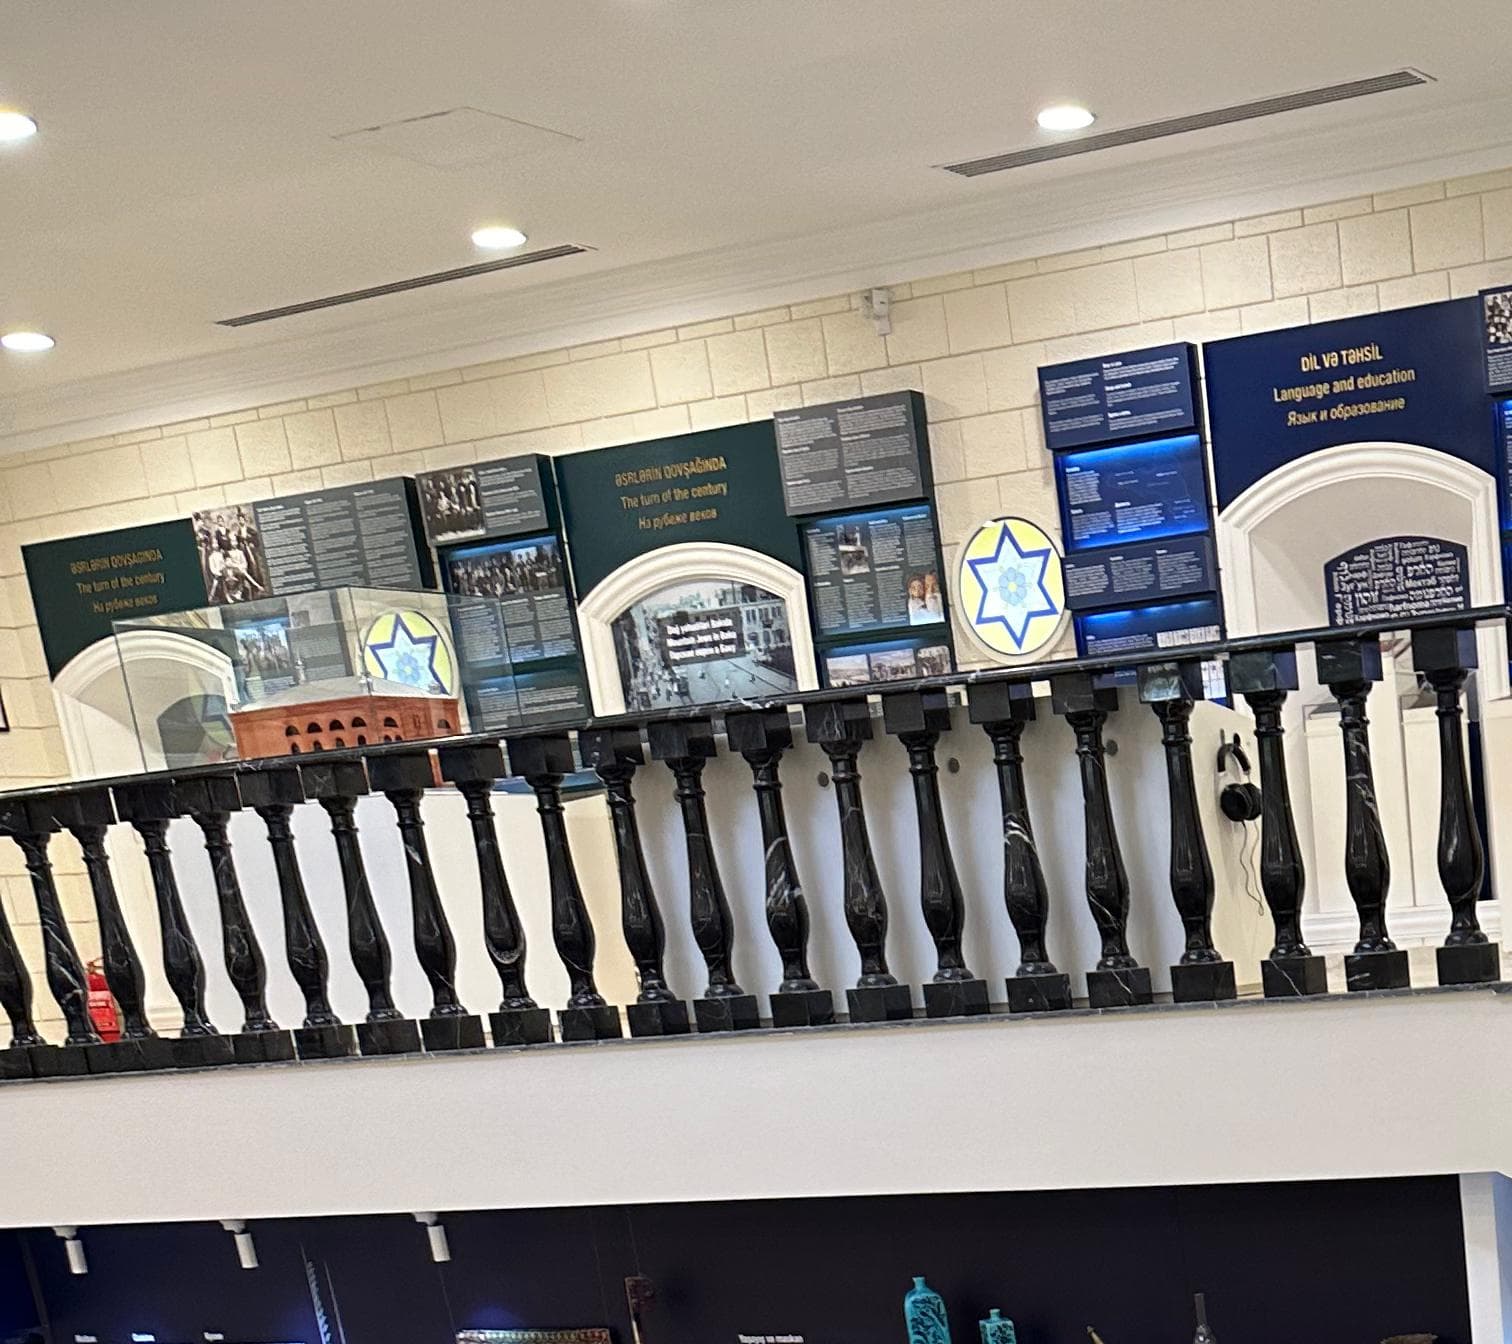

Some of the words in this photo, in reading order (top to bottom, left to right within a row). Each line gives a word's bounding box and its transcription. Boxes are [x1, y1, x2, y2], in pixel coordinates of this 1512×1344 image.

[1300, 353, 1321, 372] DİL
[1322, 351, 1338, 368] VƏ
[1341, 342, 1384, 365] TƏHSİL
[1273, 382, 1331, 402] Language
[1332, 375, 1354, 393] and
[1357, 368, 1416, 389] education
[1287, 410, 1318, 426] Язык
[1320, 409, 1328, 421] и
[1330, 397, 1406, 421] образование
[620, 496, 639, 509] The
[640, 493, 660, 506] turn
[661, 488, 672, 502] of
[673, 487, 690, 501] the
[691, 481, 728, 497] century
[638, 517, 651, 529] На
[653, 512, 688, 530] рубеже
[689, 508, 718, 522] веков
[75, 582, 92, 594] The
[93, 579, 111, 592] turn
[111, 577, 119, 589] of
[120, 577, 133, 588] the
[134, 571, 165, 586] century
